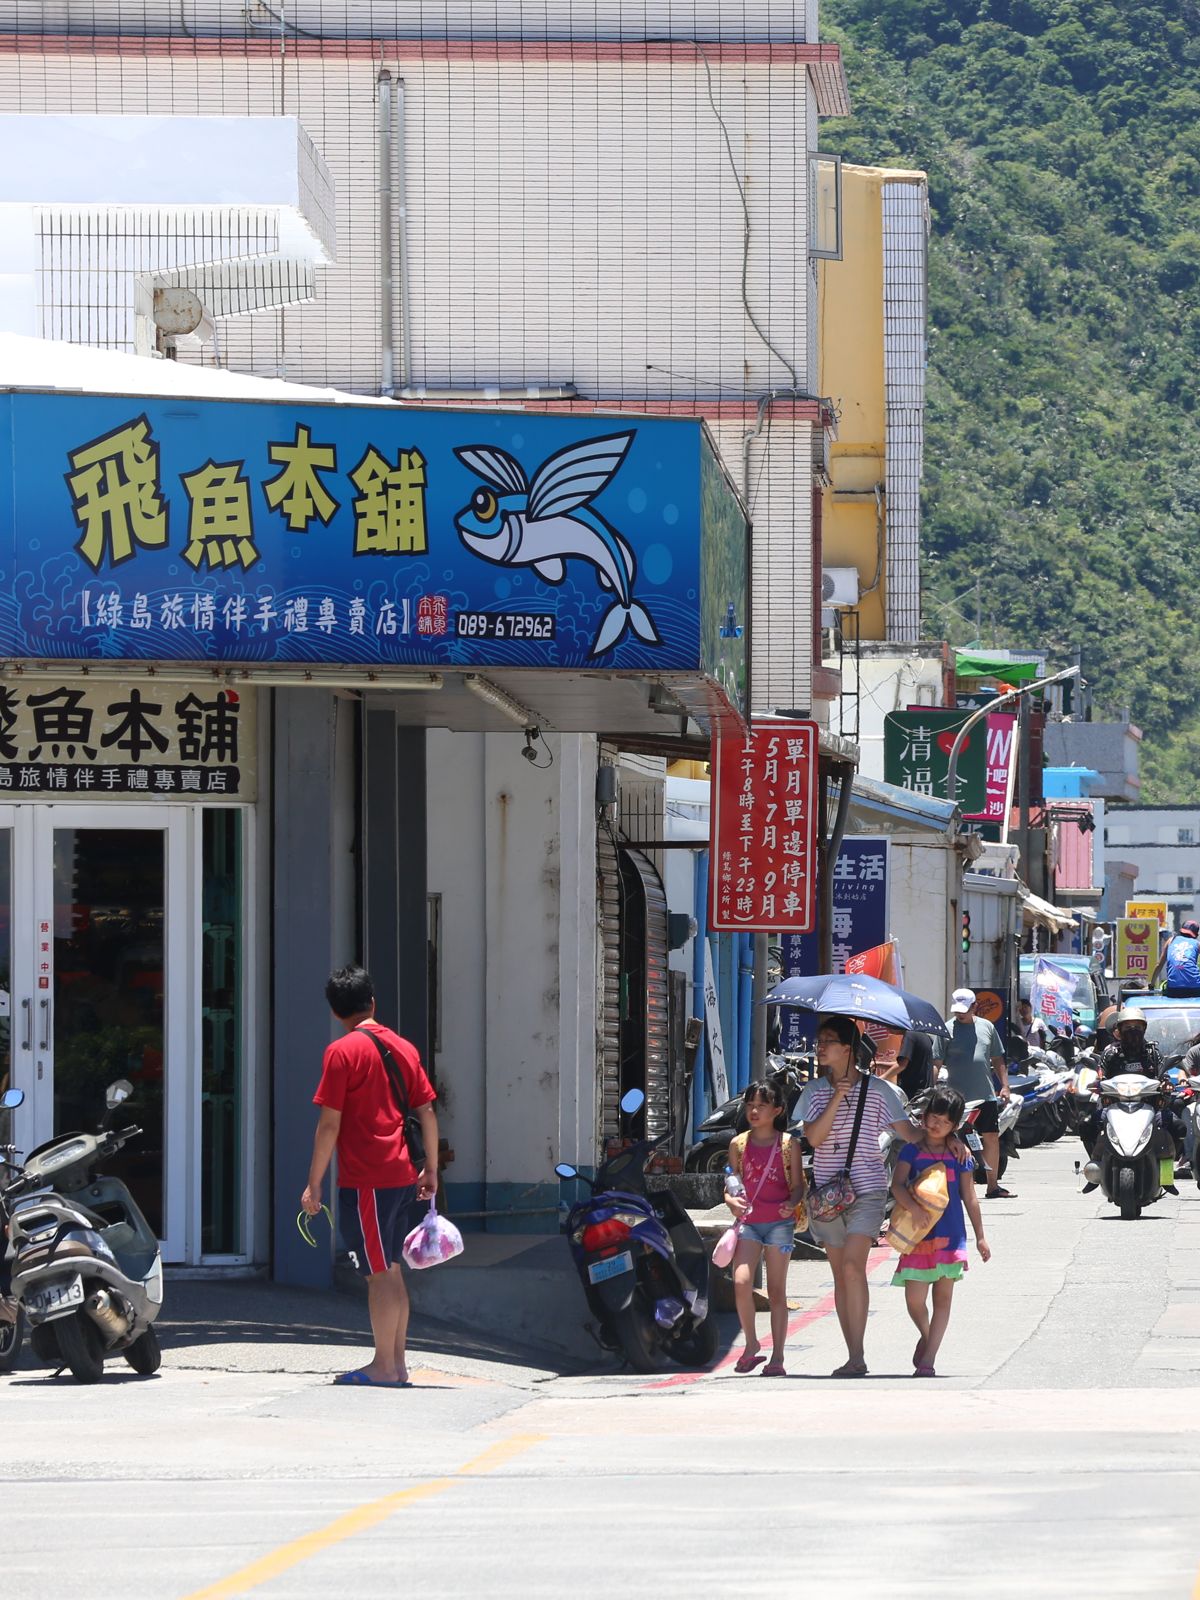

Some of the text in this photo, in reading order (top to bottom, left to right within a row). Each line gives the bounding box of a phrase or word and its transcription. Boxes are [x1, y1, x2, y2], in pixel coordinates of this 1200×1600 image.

[62, 413, 430, 573] 飛魚本舖
[458, 614, 552, 638] 089-672962
[899, 725, 931, 761] 清
[781, 738, 808, 918] 單月單邊停車
